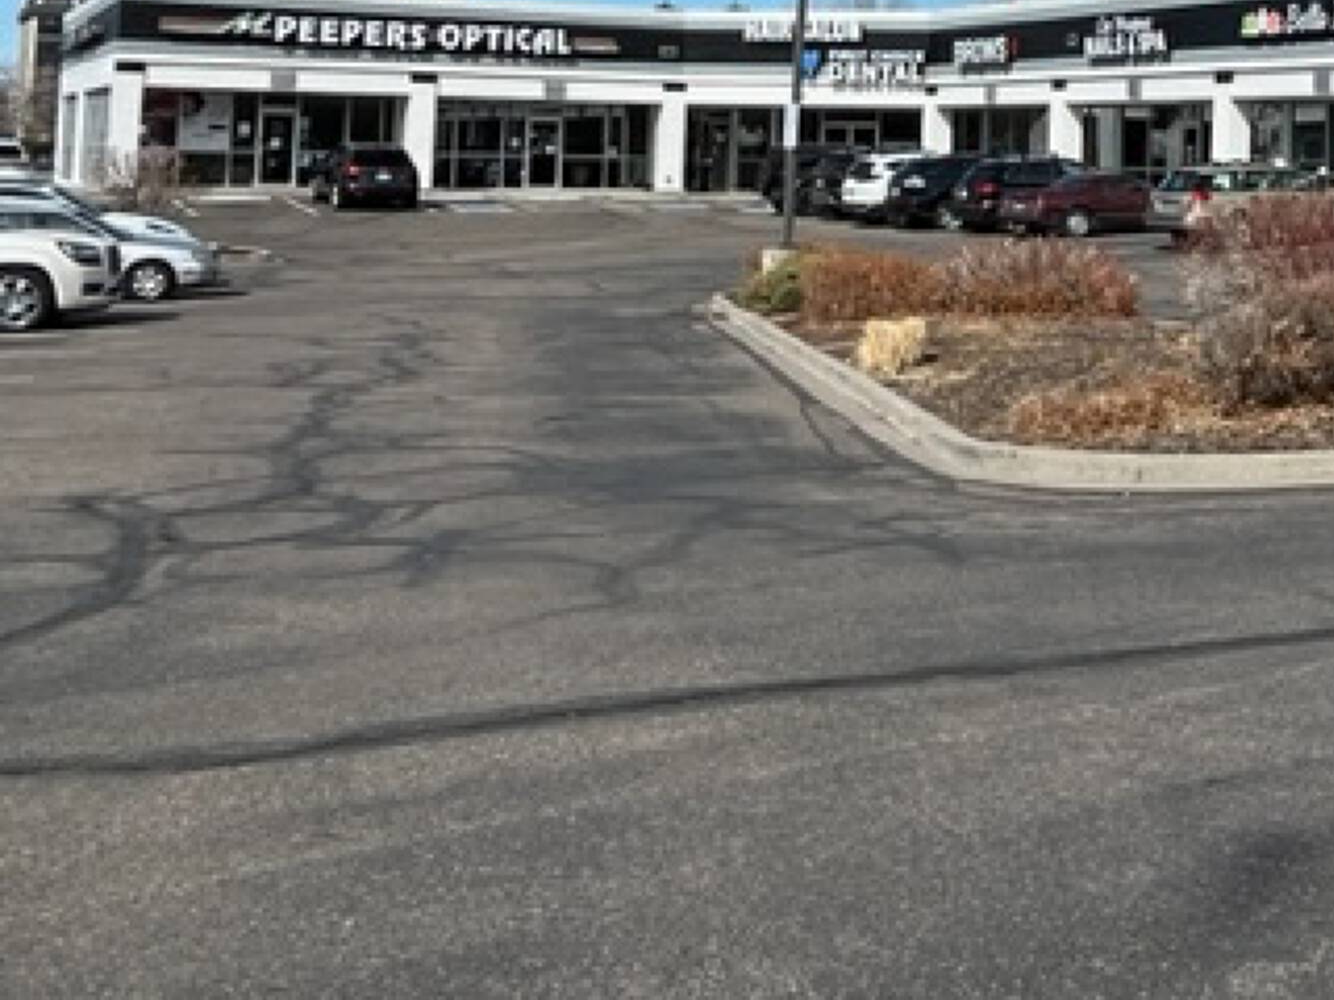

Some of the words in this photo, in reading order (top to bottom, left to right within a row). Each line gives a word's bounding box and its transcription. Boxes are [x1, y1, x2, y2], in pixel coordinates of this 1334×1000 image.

[273, 15, 428, 50] PEEPERS
[437, 22, 572, 56] OPTICAL
[828, 61, 925, 81] DENTAL
